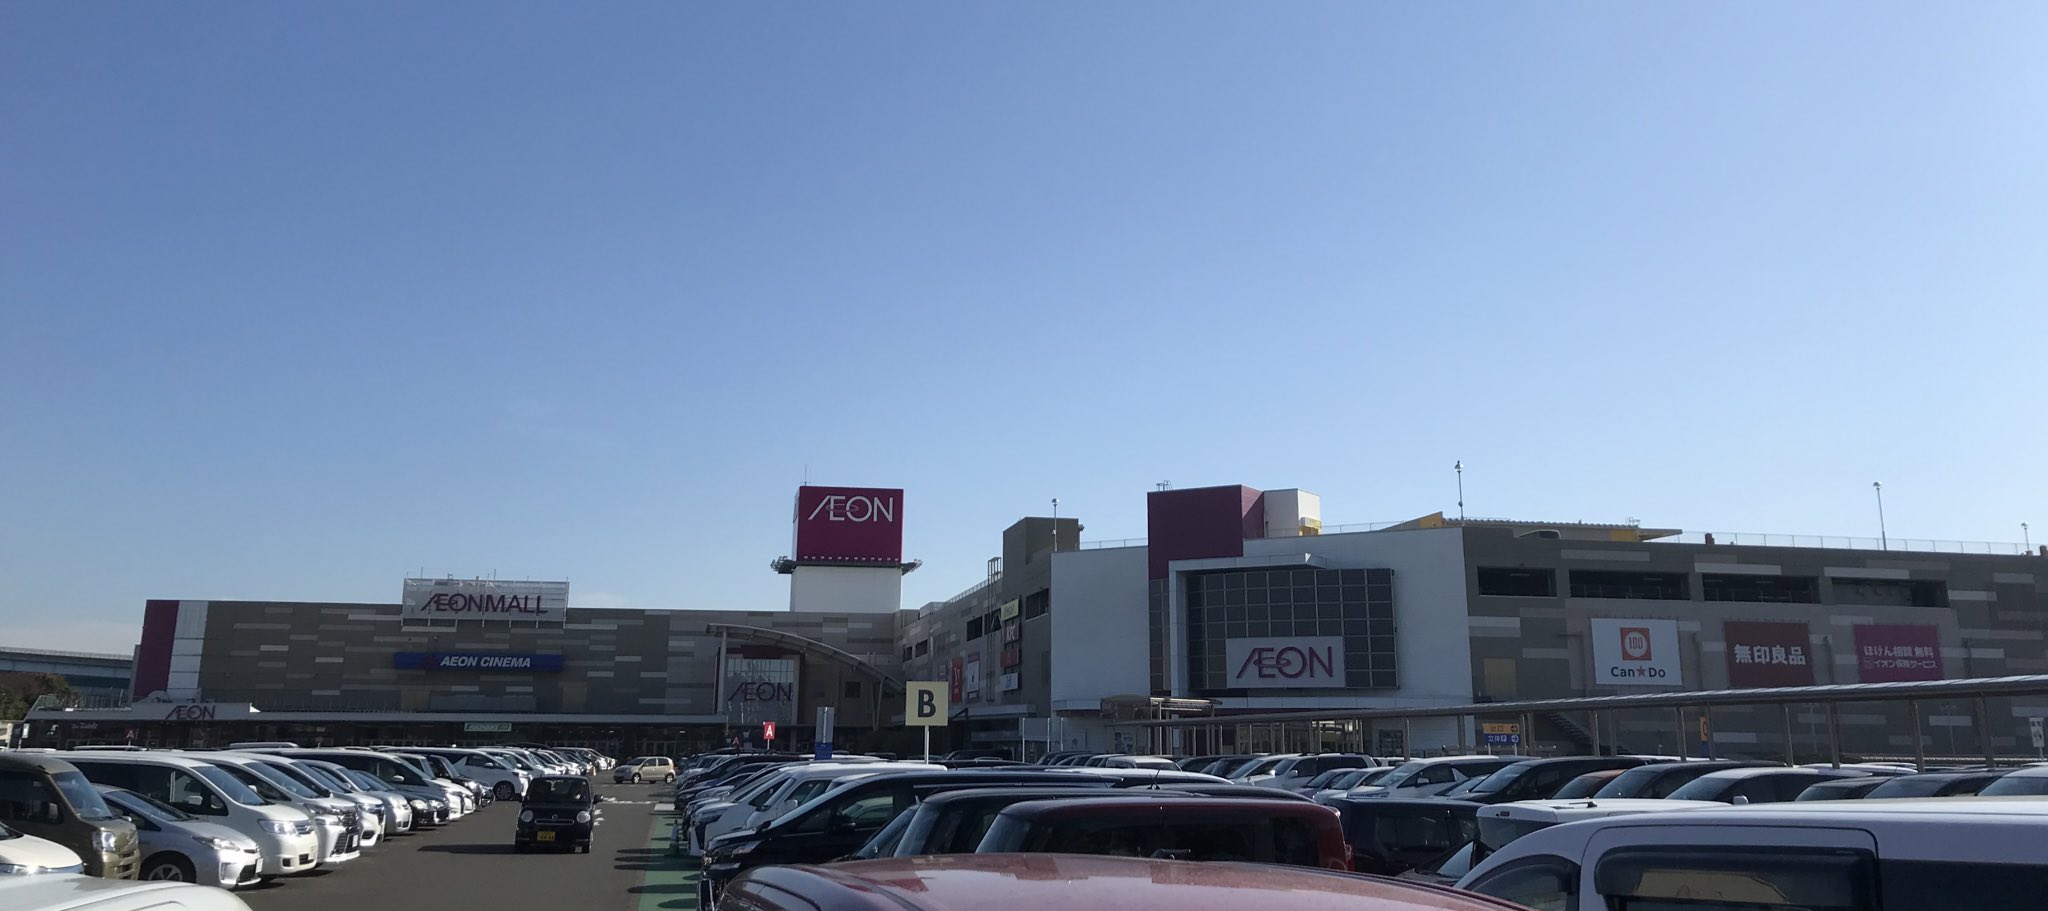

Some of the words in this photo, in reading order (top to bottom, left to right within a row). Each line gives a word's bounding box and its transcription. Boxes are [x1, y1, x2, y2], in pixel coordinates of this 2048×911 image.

[1734, 643, 1806, 665] 無印良品
[1863, 645, 1913, 657] ほけん相談
[1914, 646, 1934, 658] 無料
[440, 656, 479, 668] AEON
[480, 656, 532, 668] CINEMA
[917, 689, 936, 718] B
[126, 729, 135, 740] A
[765, 724, 774, 737] A
[732, 736, 740, 745] A
